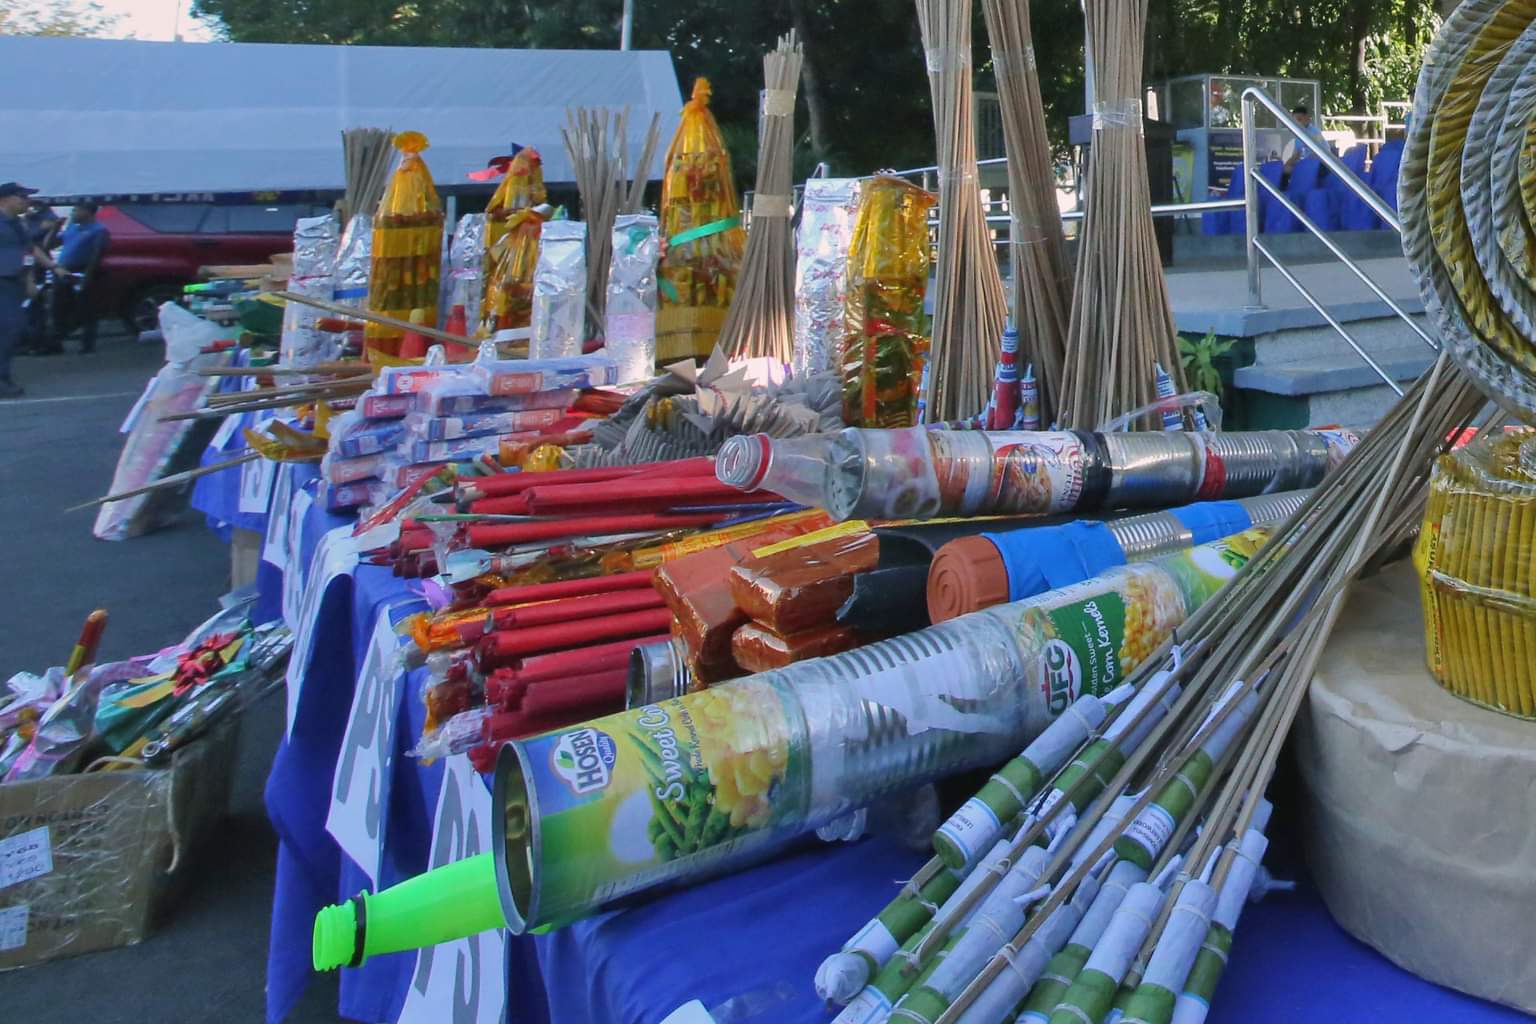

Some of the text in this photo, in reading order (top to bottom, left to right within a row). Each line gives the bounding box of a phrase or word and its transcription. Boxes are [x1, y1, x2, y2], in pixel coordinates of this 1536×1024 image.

[1083, 600, 1112, 648] Kernels
[1084, 632, 1099, 667] Sweet
[1103, 648, 1114, 683] Corn
[1046, 645, 1070, 716] UFC
[568, 730, 604, 790] HOSEN
[599, 735, 616, 764] Quality
[653, 727, 685, 802] Sweet
